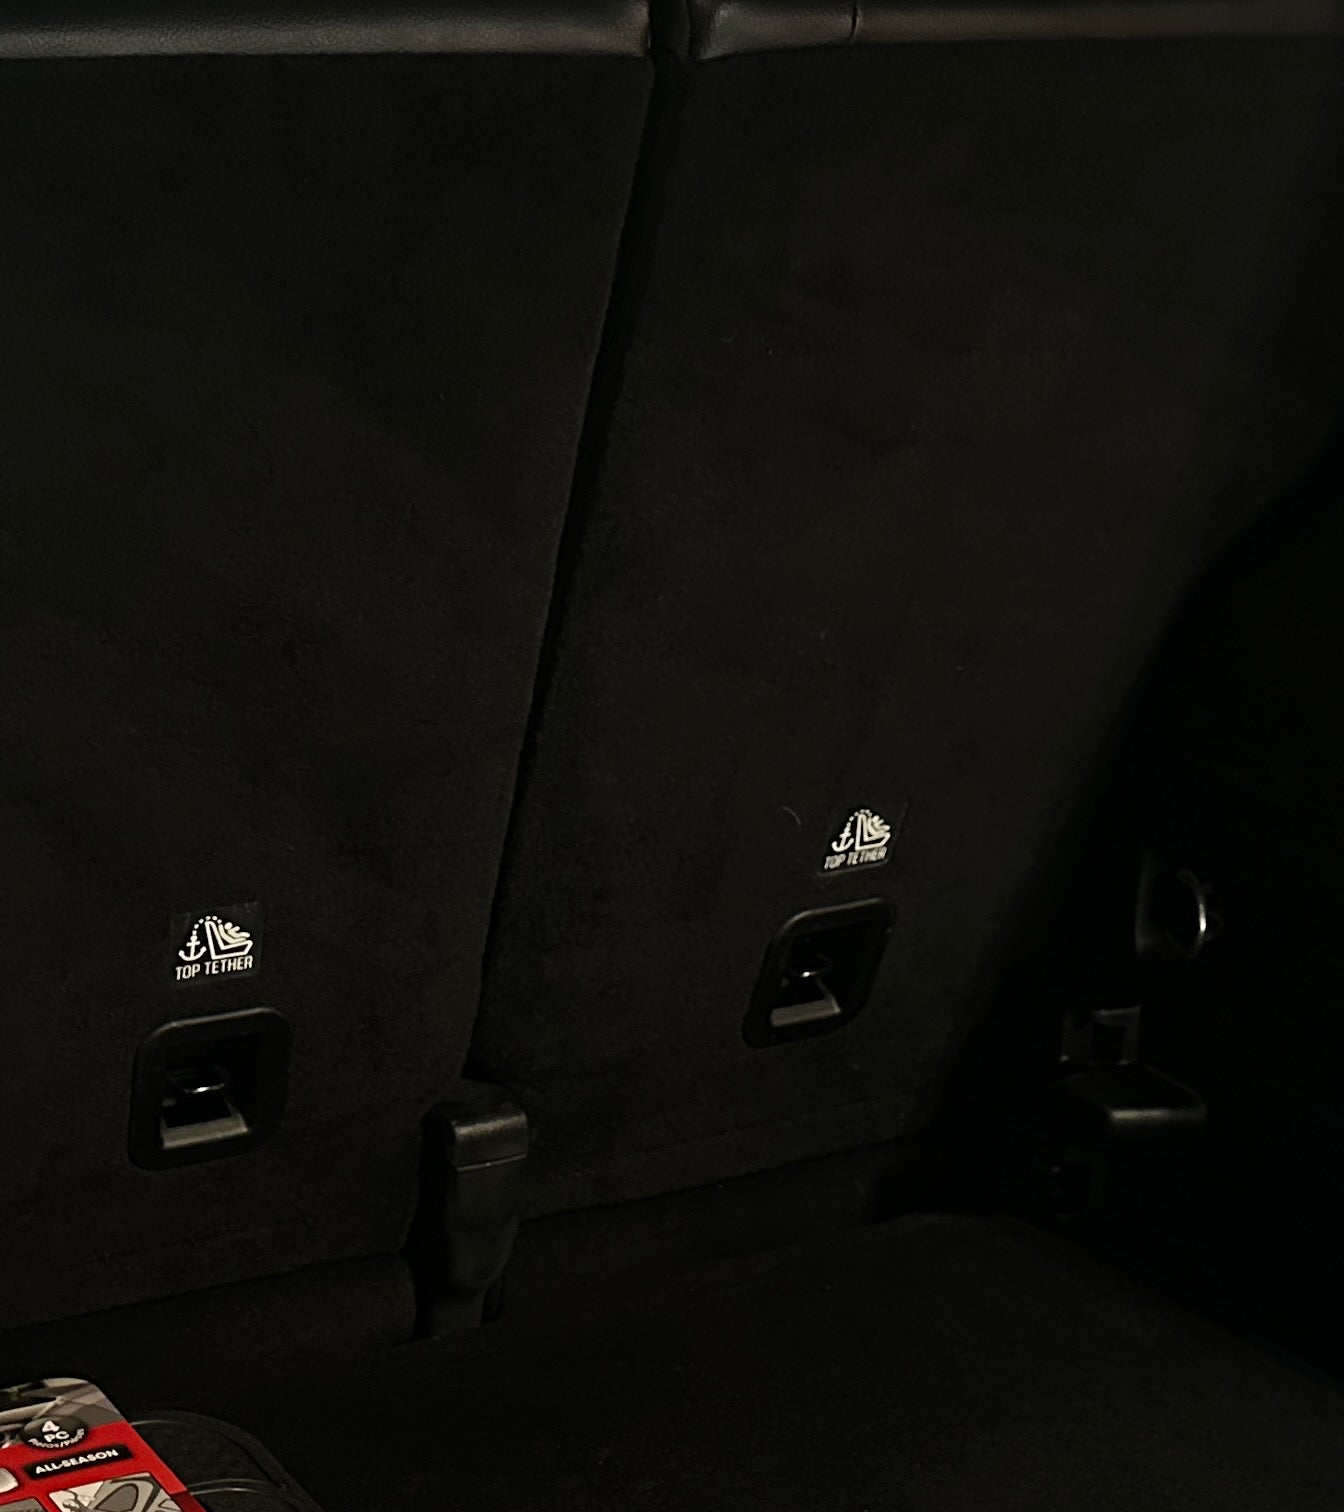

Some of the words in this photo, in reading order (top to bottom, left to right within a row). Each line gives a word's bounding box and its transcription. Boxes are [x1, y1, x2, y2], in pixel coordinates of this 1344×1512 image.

[175, 963, 200, 980] TOP
[204, 955, 253, 975] TETHER
[42, 1420, 60, 1432] 4
[44, 1431, 69, 1442] PC
[36, 1449, 118, 1474] ALL-SEASON
